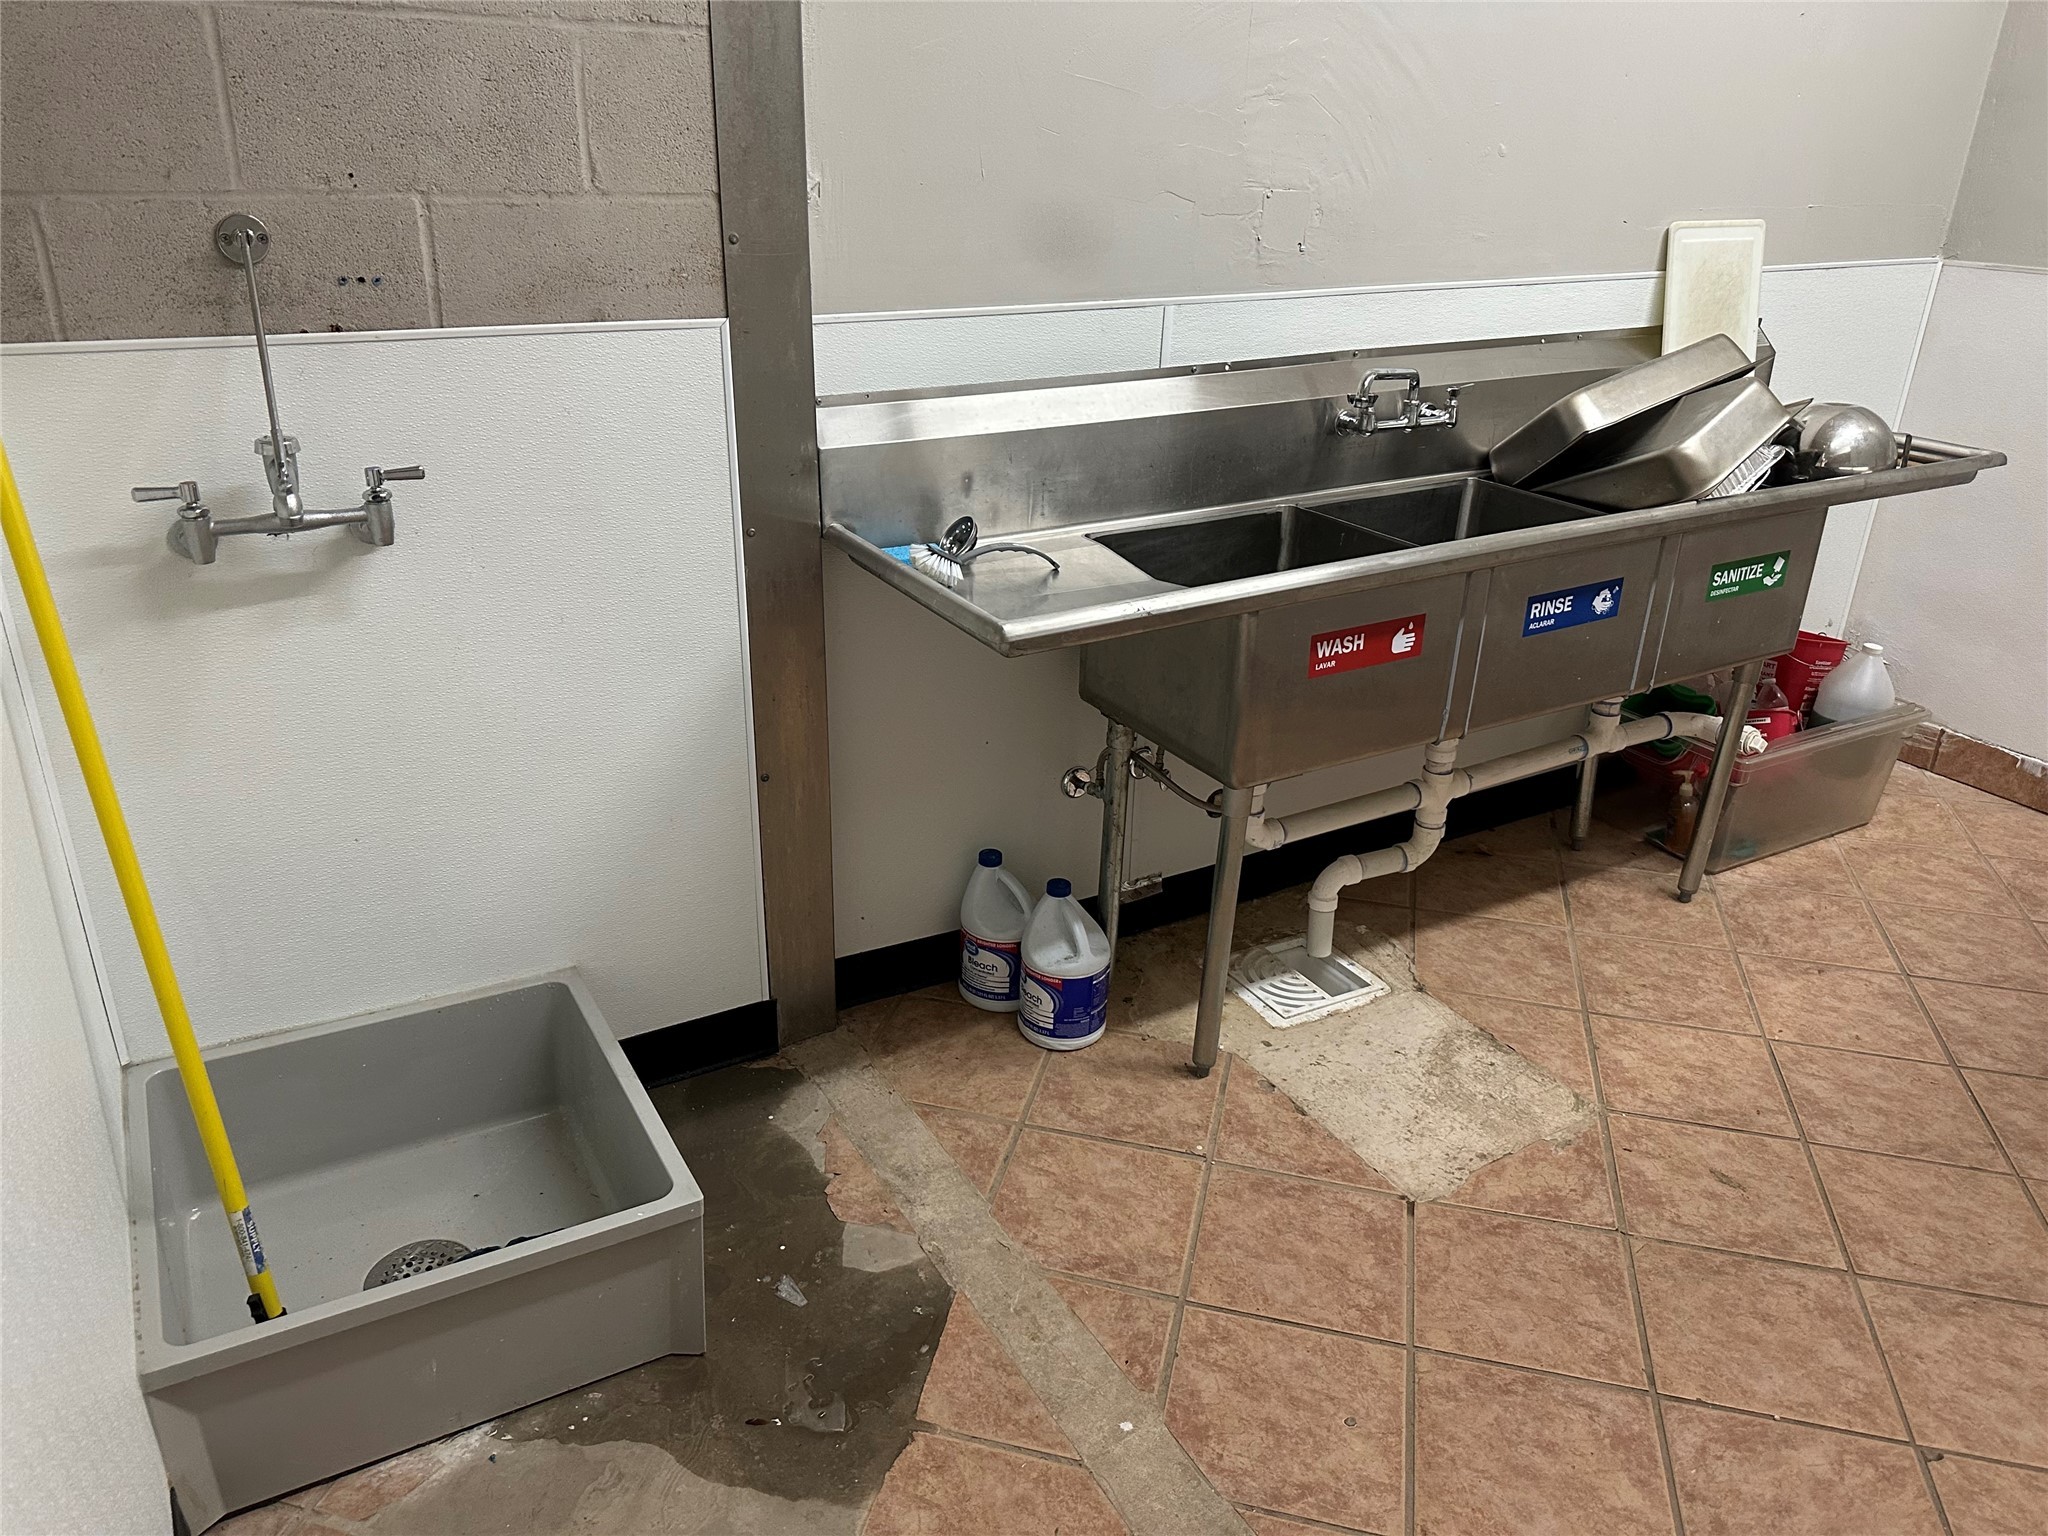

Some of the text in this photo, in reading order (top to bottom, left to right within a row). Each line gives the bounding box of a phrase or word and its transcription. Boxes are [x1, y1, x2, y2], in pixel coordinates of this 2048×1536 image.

[1712, 563, 1765, 587] SANITIZE
[1530, 596, 1574, 619] RINSE
[1528, 618, 1555, 630] ACLARAR
[1316, 633, 1365, 659] WASH
[1315, 660, 1336, 671] LAVAR
[967, 955, 999, 972] Bleach
[247, 1219, 261, 1253] SUPPLY
